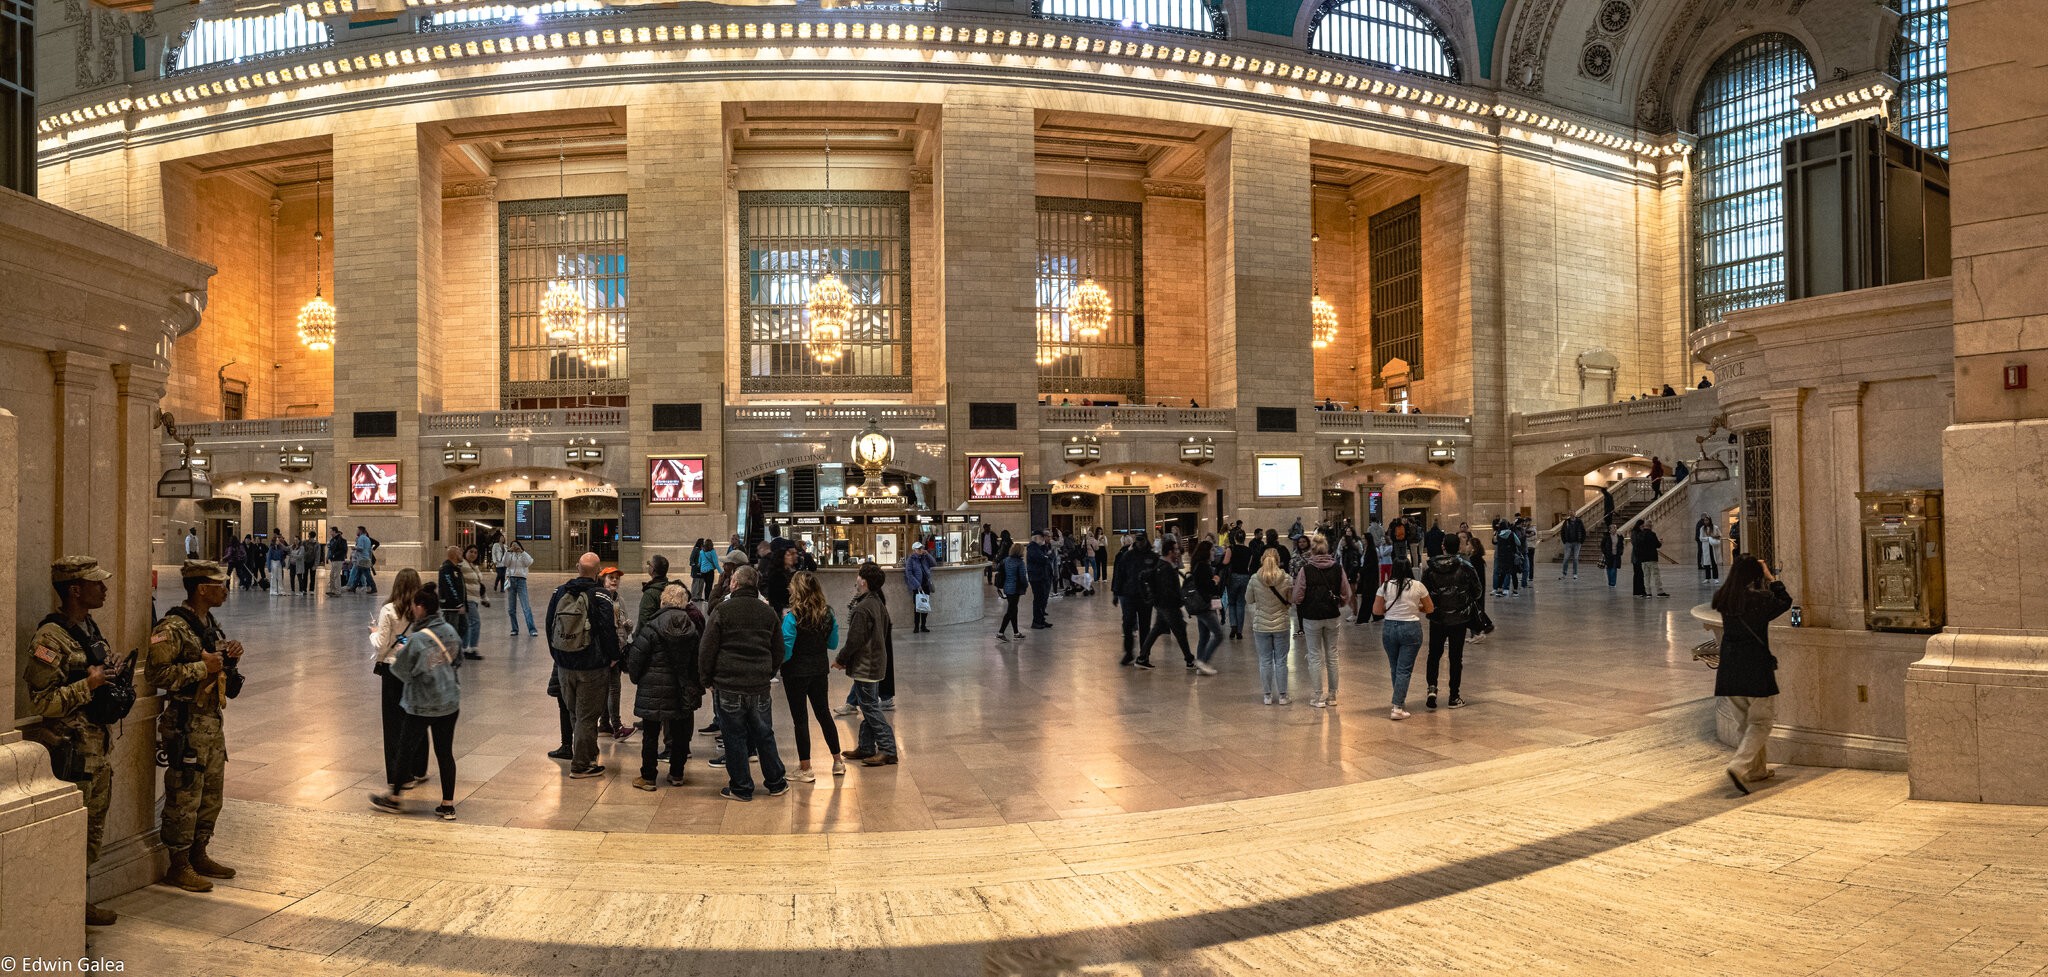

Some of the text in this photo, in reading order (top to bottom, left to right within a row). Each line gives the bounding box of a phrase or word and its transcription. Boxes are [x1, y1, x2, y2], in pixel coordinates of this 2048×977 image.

[735, 454, 825, 479] THE METLIFE BUILDING
[864, 497, 897, 505] Information
